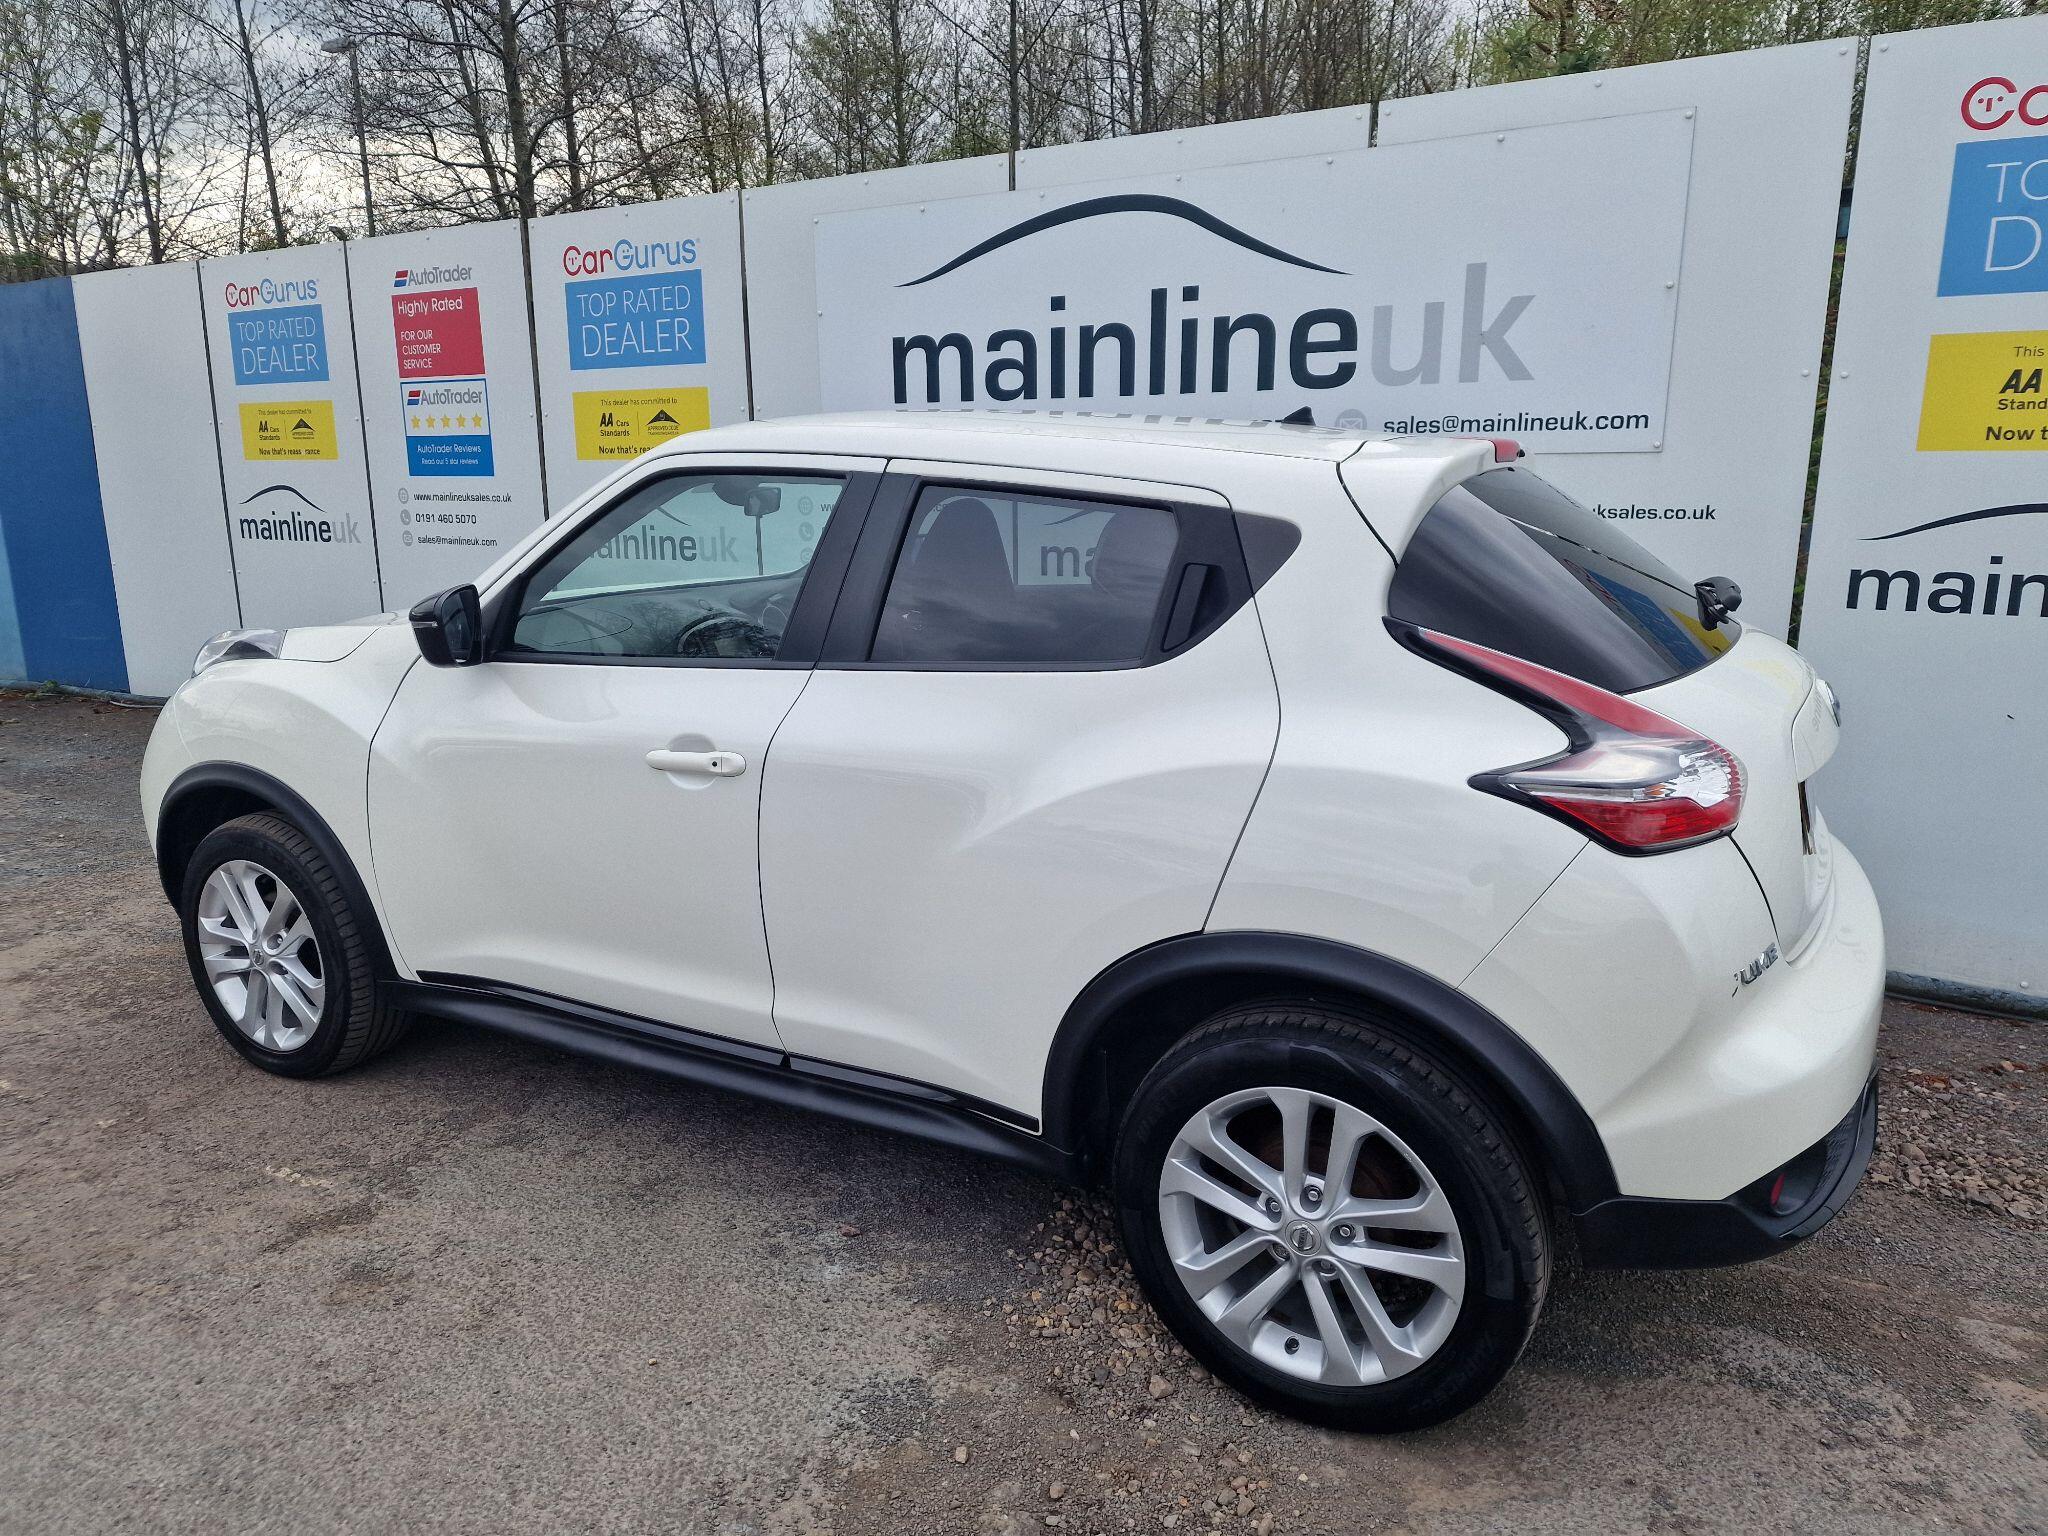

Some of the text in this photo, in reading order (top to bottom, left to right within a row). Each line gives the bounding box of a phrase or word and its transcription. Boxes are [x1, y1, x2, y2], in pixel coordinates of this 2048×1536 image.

[563, 239, 697, 276] CarGurus
[407, 264, 473, 286] AutoTrader
[225, 278, 318, 308] CarGurus
[397, 296, 463, 317] Highly Rated
[576, 285, 691, 318] TOP RATED
[236, 316, 316, 342] TOP RATED
[400, 329, 433, 341] FOR OUR
[893, 263, 1536, 405] mainlineuk
[582, 317, 693, 357] DEALER
[402, 343, 441, 355] CUSTOMER
[2013, 346, 2045, 357] This
[241, 343, 320, 375] DEALER
[403, 358, 432, 370] SERVICE
[1998, 368, 2043, 394] AA
[420, 388, 482, 405] AutoTrader
[259, 420, 268, 433] AA
[600, 412, 614, 427] AA
[1384, 411, 1649, 434] sales@mainlineuk.com
[600, 429, 630, 437] Standards
[1985, 426, 2036, 441] Now
[259, 448, 271, 456] Now
[417, 443, 481, 454] AutoTrader Reviews
[599, 446, 616, 454] Now
[617, 445, 638, 454] that's
[413, 492, 512, 503] www.mainlineuksales.co.uk
[415, 513, 477, 524] 0191 460 5070
[1593, 504, 1716, 520] ksales.co.uk
[239, 510, 362, 543] mainlineuk
[417, 534, 498, 547] sales@mainlineuk.com
